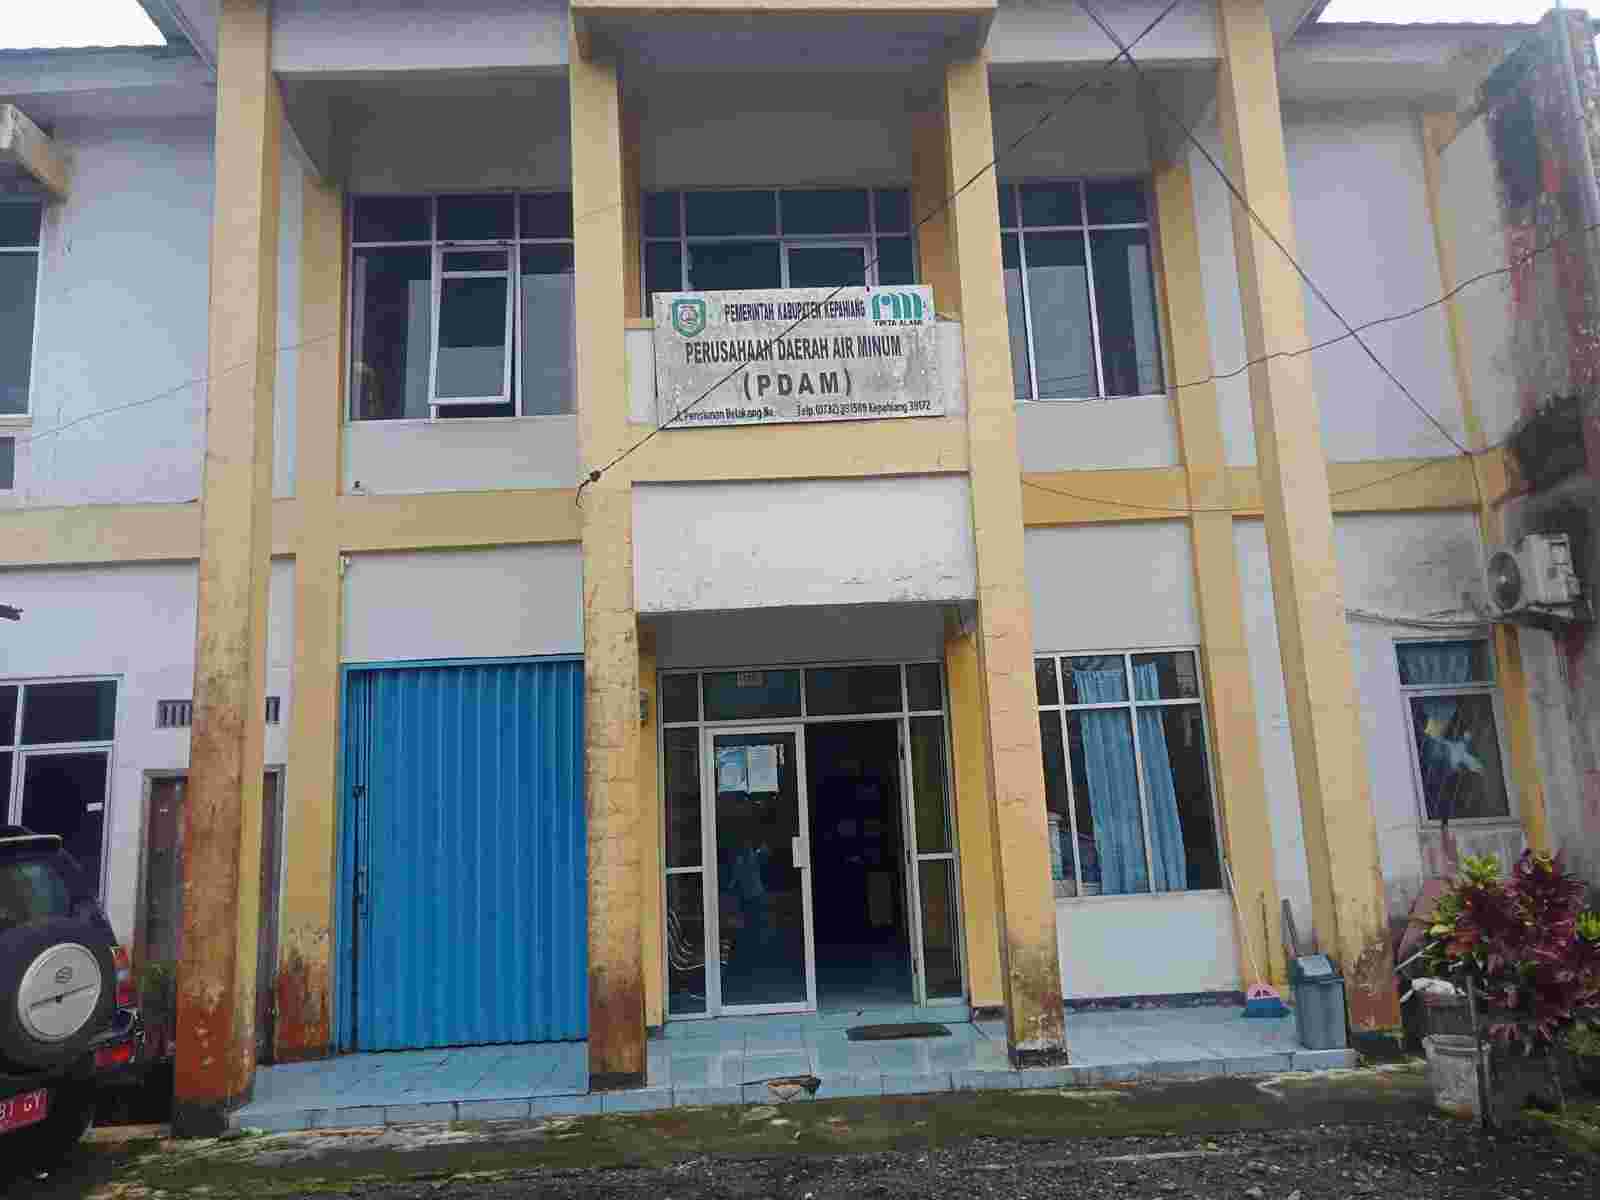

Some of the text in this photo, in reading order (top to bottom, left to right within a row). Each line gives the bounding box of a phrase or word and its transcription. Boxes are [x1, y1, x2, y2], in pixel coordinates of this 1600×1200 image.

[724, 302, 775, 321] PEMERINTAH
[823, 299, 866, 319] KEPAHIANG
[685, 335, 903, 364] PERUSAHAAN DAERAH AIR MINUM
